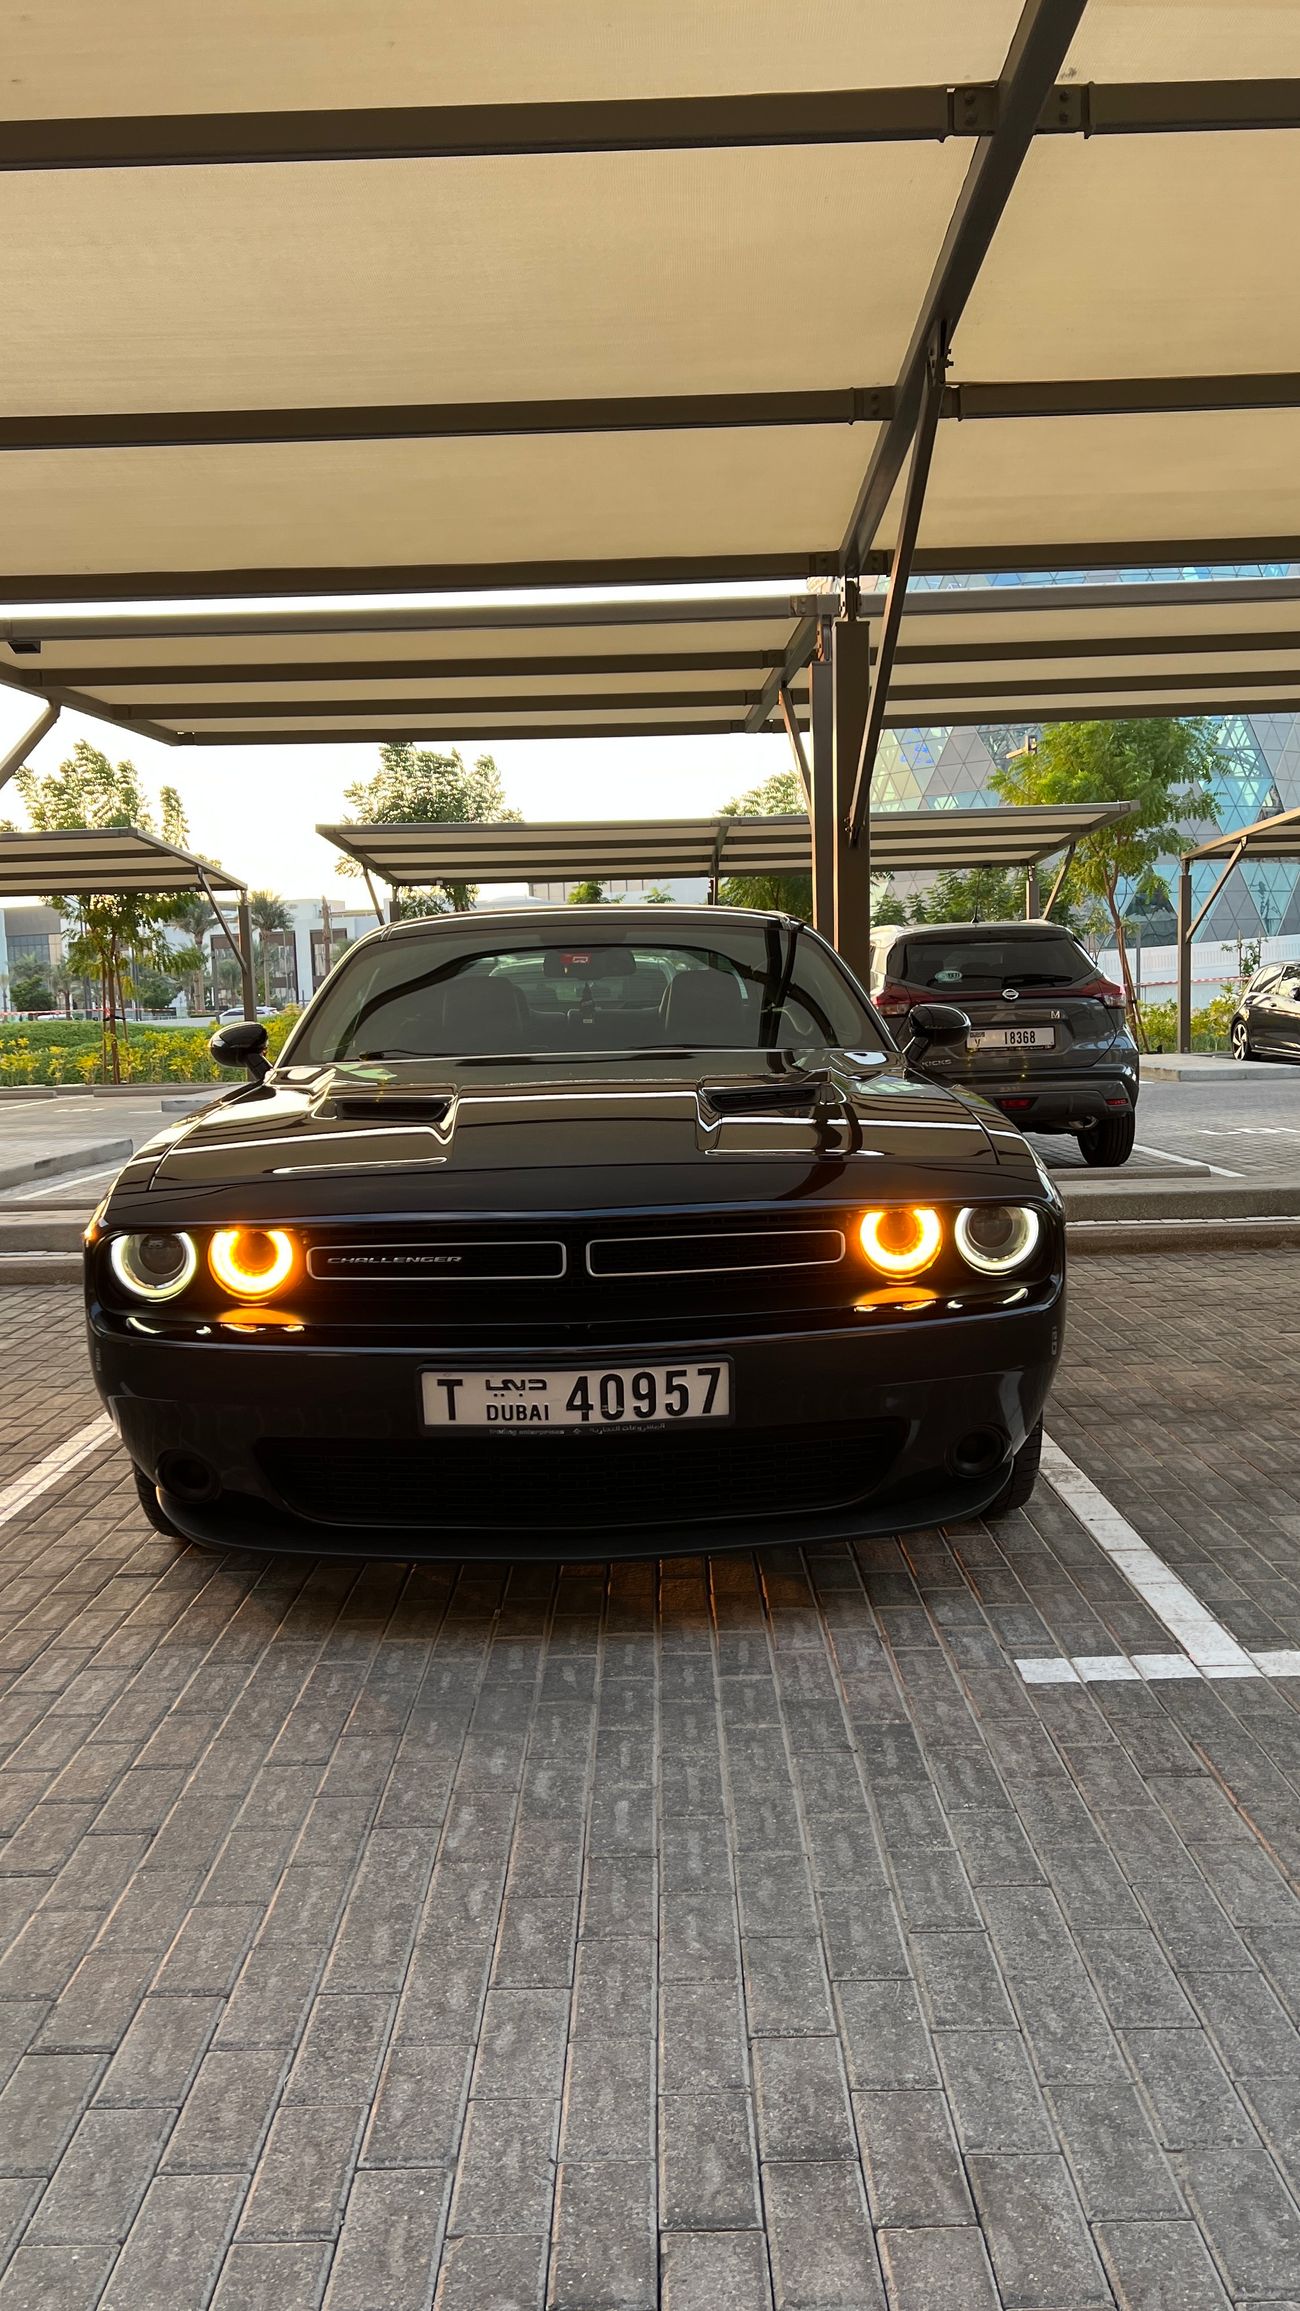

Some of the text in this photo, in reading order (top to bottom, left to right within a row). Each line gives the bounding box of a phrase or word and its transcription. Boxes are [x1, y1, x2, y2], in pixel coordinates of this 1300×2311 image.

[1004, 1030, 1036, 1045] 18368
[327, 1256, 463, 1264] CHALLENGER
[437, 1367, 721, 1422] T 40957
[486, 1403, 550, 1421] DUBAI
